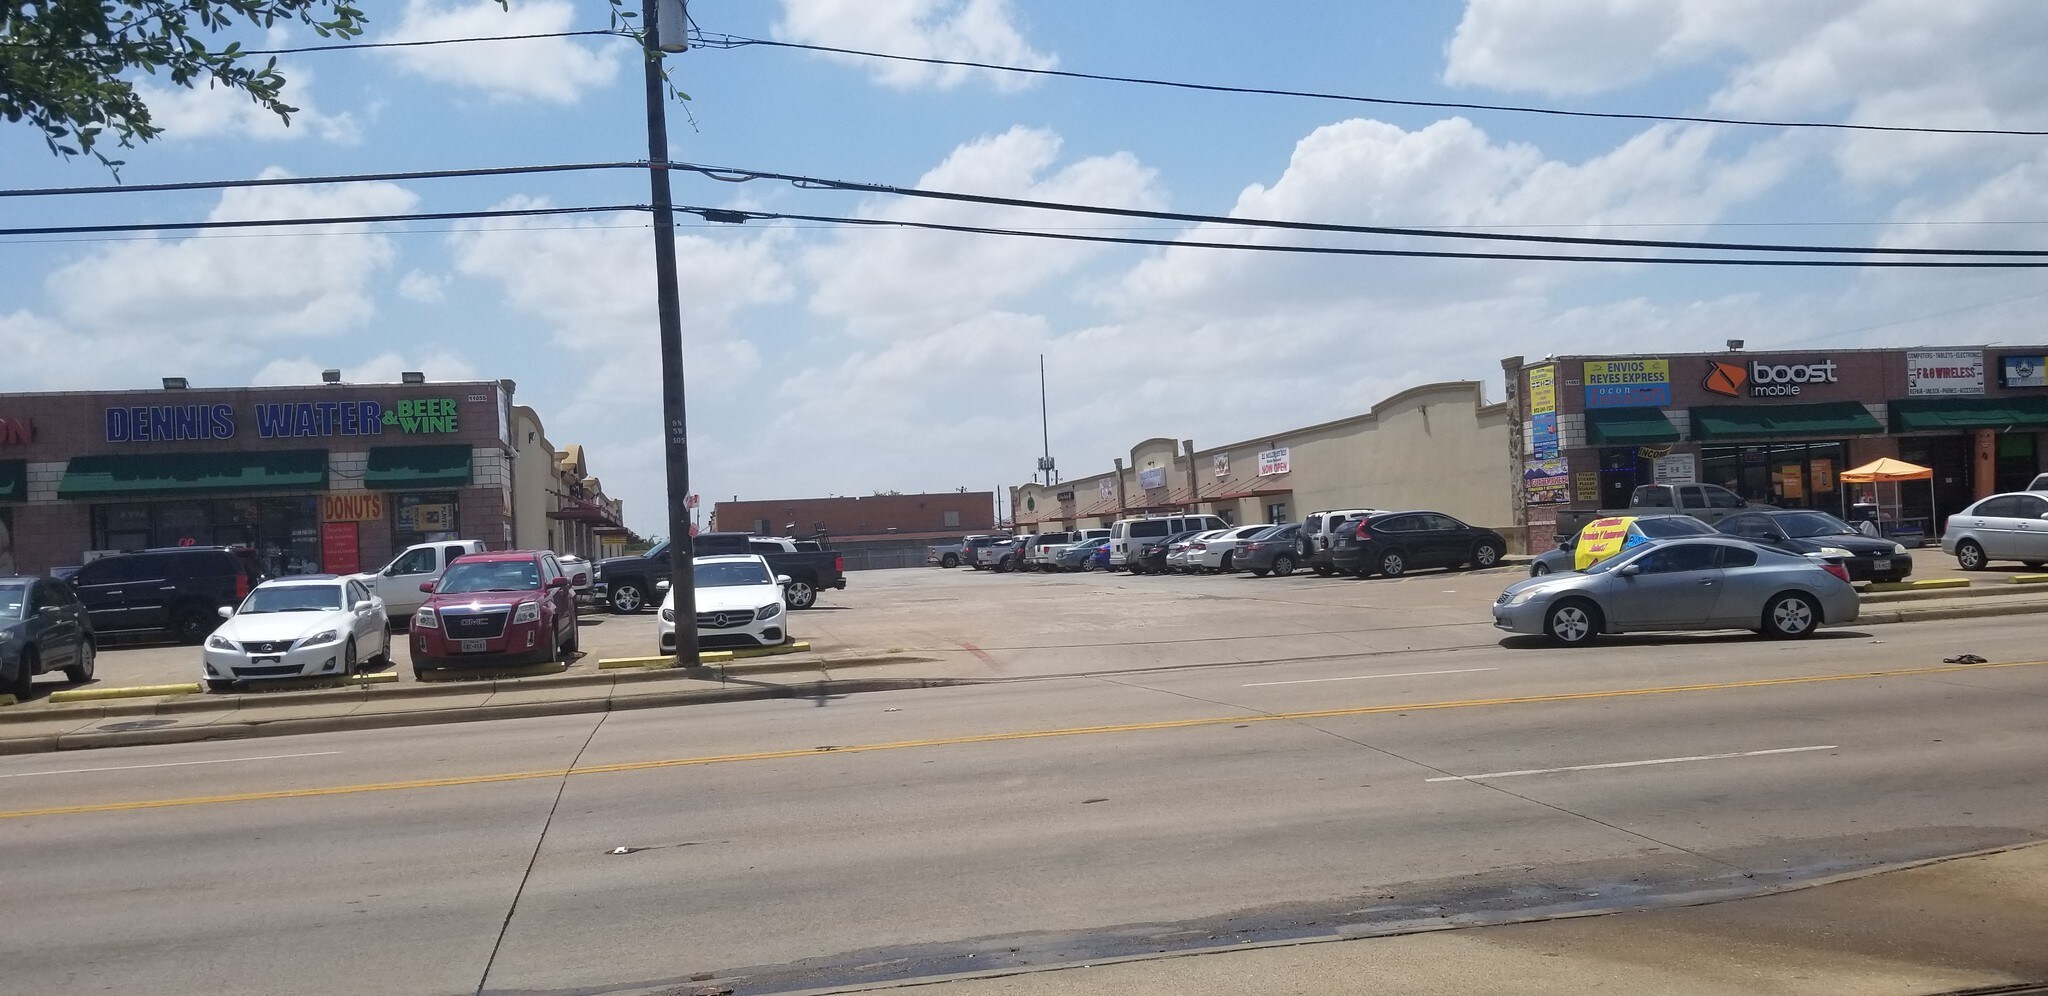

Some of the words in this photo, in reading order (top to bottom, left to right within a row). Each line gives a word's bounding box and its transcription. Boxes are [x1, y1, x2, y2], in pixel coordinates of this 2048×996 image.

[1608, 362, 1644, 373] ENVIOS
[1753, 360, 1837, 383] boost
[1935, 367, 1975, 379] WIRELESS
[1590, 374, 1620, 384] REYES
[1622, 372, 1665, 383] EXPRESS
[1755, 384, 1800, 396] mobile
[106, 404, 235, 442] DENNIS
[255, 401, 382, 438] WATER
[382, 410, 399, 425] &
[398, 399, 457, 417] BEER
[400, 416, 458, 434] WINE
[1262, 464, 1273, 474] NOW
[1274, 462, 1287, 472] OPEN
[325, 495, 380, 519] DONUTS
